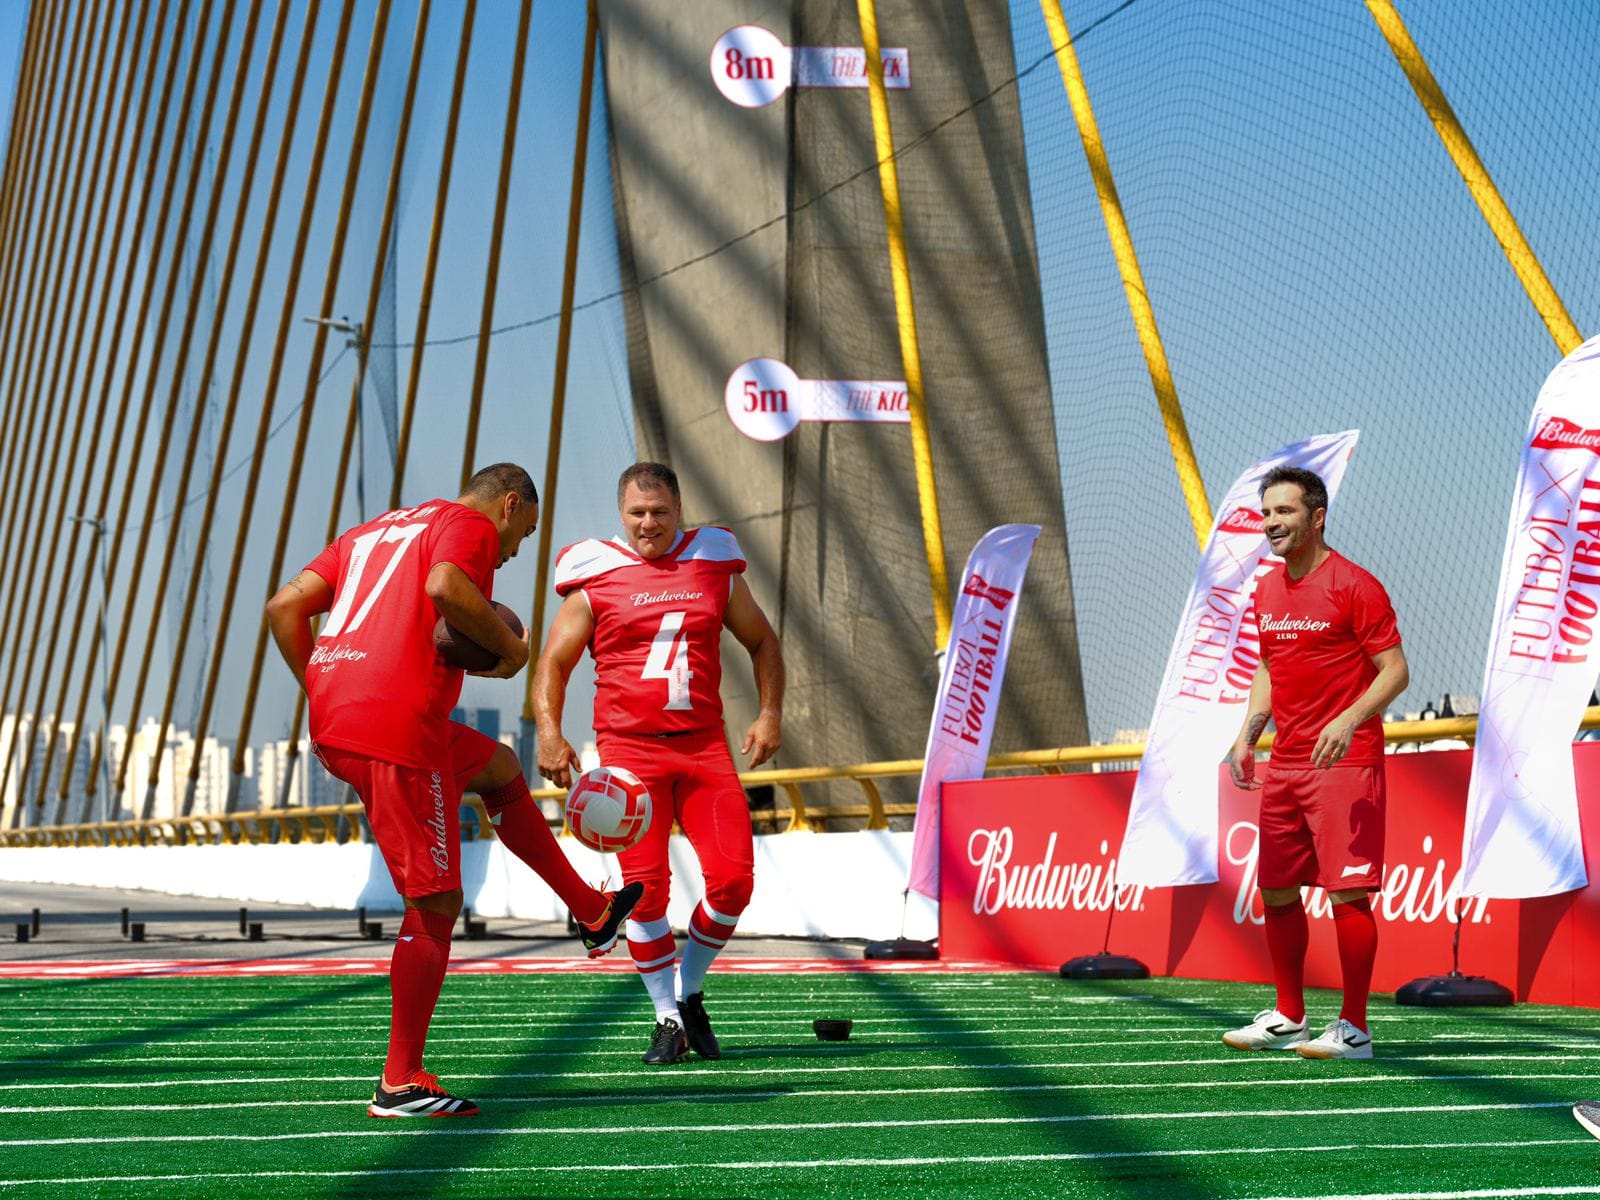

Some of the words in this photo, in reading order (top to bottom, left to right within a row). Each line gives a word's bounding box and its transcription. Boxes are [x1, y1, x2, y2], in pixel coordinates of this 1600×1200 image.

[725, 48, 775, 80] 8m
[831, 56, 859, 77] THE
[863, 56, 903, 78] CK
[743, 381, 788, 413] 5m
[846, 390, 874, 411] THE
[877, 390, 910, 411] KIC
[320, 523, 429, 637] 17
[1510, 508, 1571, 660] FUTEBOL
[630, 590, 704, 606] Budweiser
[1260, 613, 1331, 632] Budweiser
[1276, 632, 1299, 640] ZERO
[1179, 581, 1244, 702] FUTEBOL
[640, 611, 694, 710] 4
[941, 637, 979, 737] FUTEBOL
[960, 619, 1004, 745] FOOTBALL
